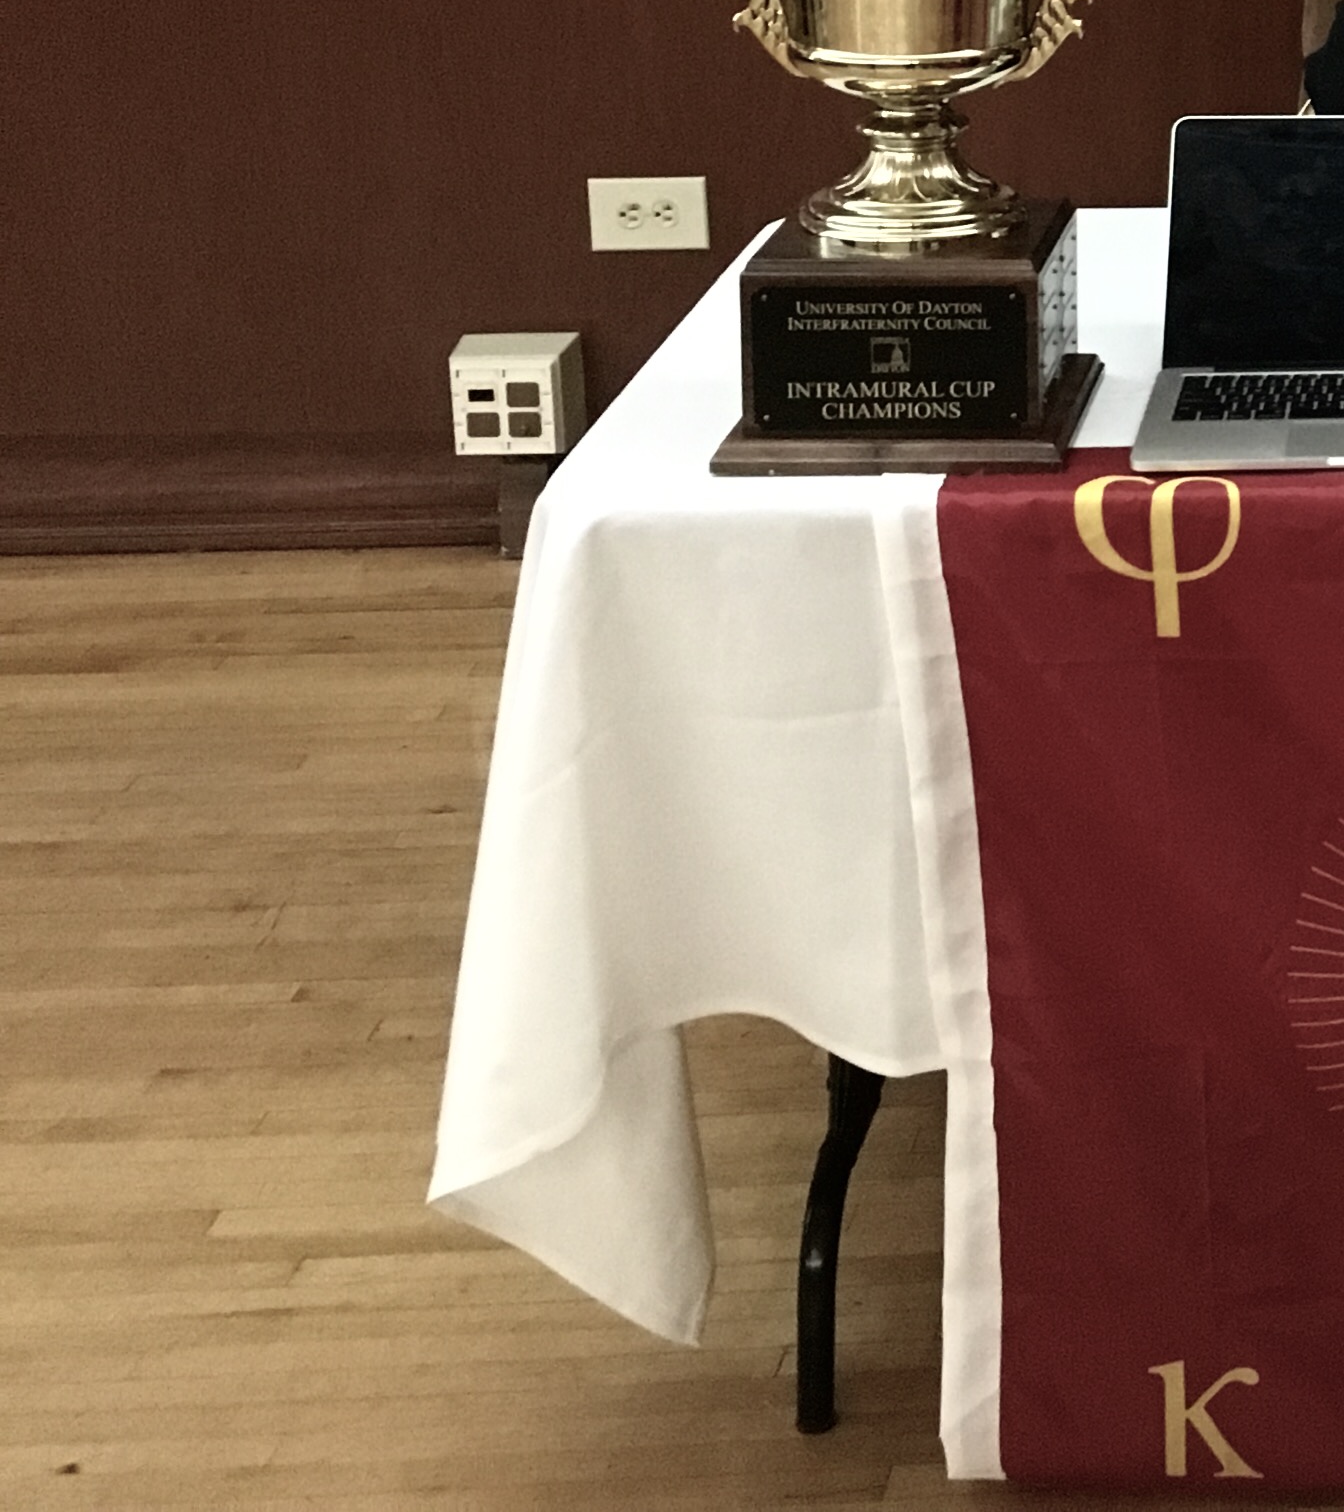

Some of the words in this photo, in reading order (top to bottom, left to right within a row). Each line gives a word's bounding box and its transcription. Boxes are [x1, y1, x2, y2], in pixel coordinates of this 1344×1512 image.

[796, 300, 889, 316] UNIVERSITY
[919, 300, 983, 315] DAYTON
[787, 316, 921, 332] INTERFRATERNITY
[924, 316, 991, 331] COUNCIL
[787, 381, 945, 399] INTRAMURAL
[949, 380, 996, 399] CUP
[821, 401, 962, 421] CHAMPIONS
